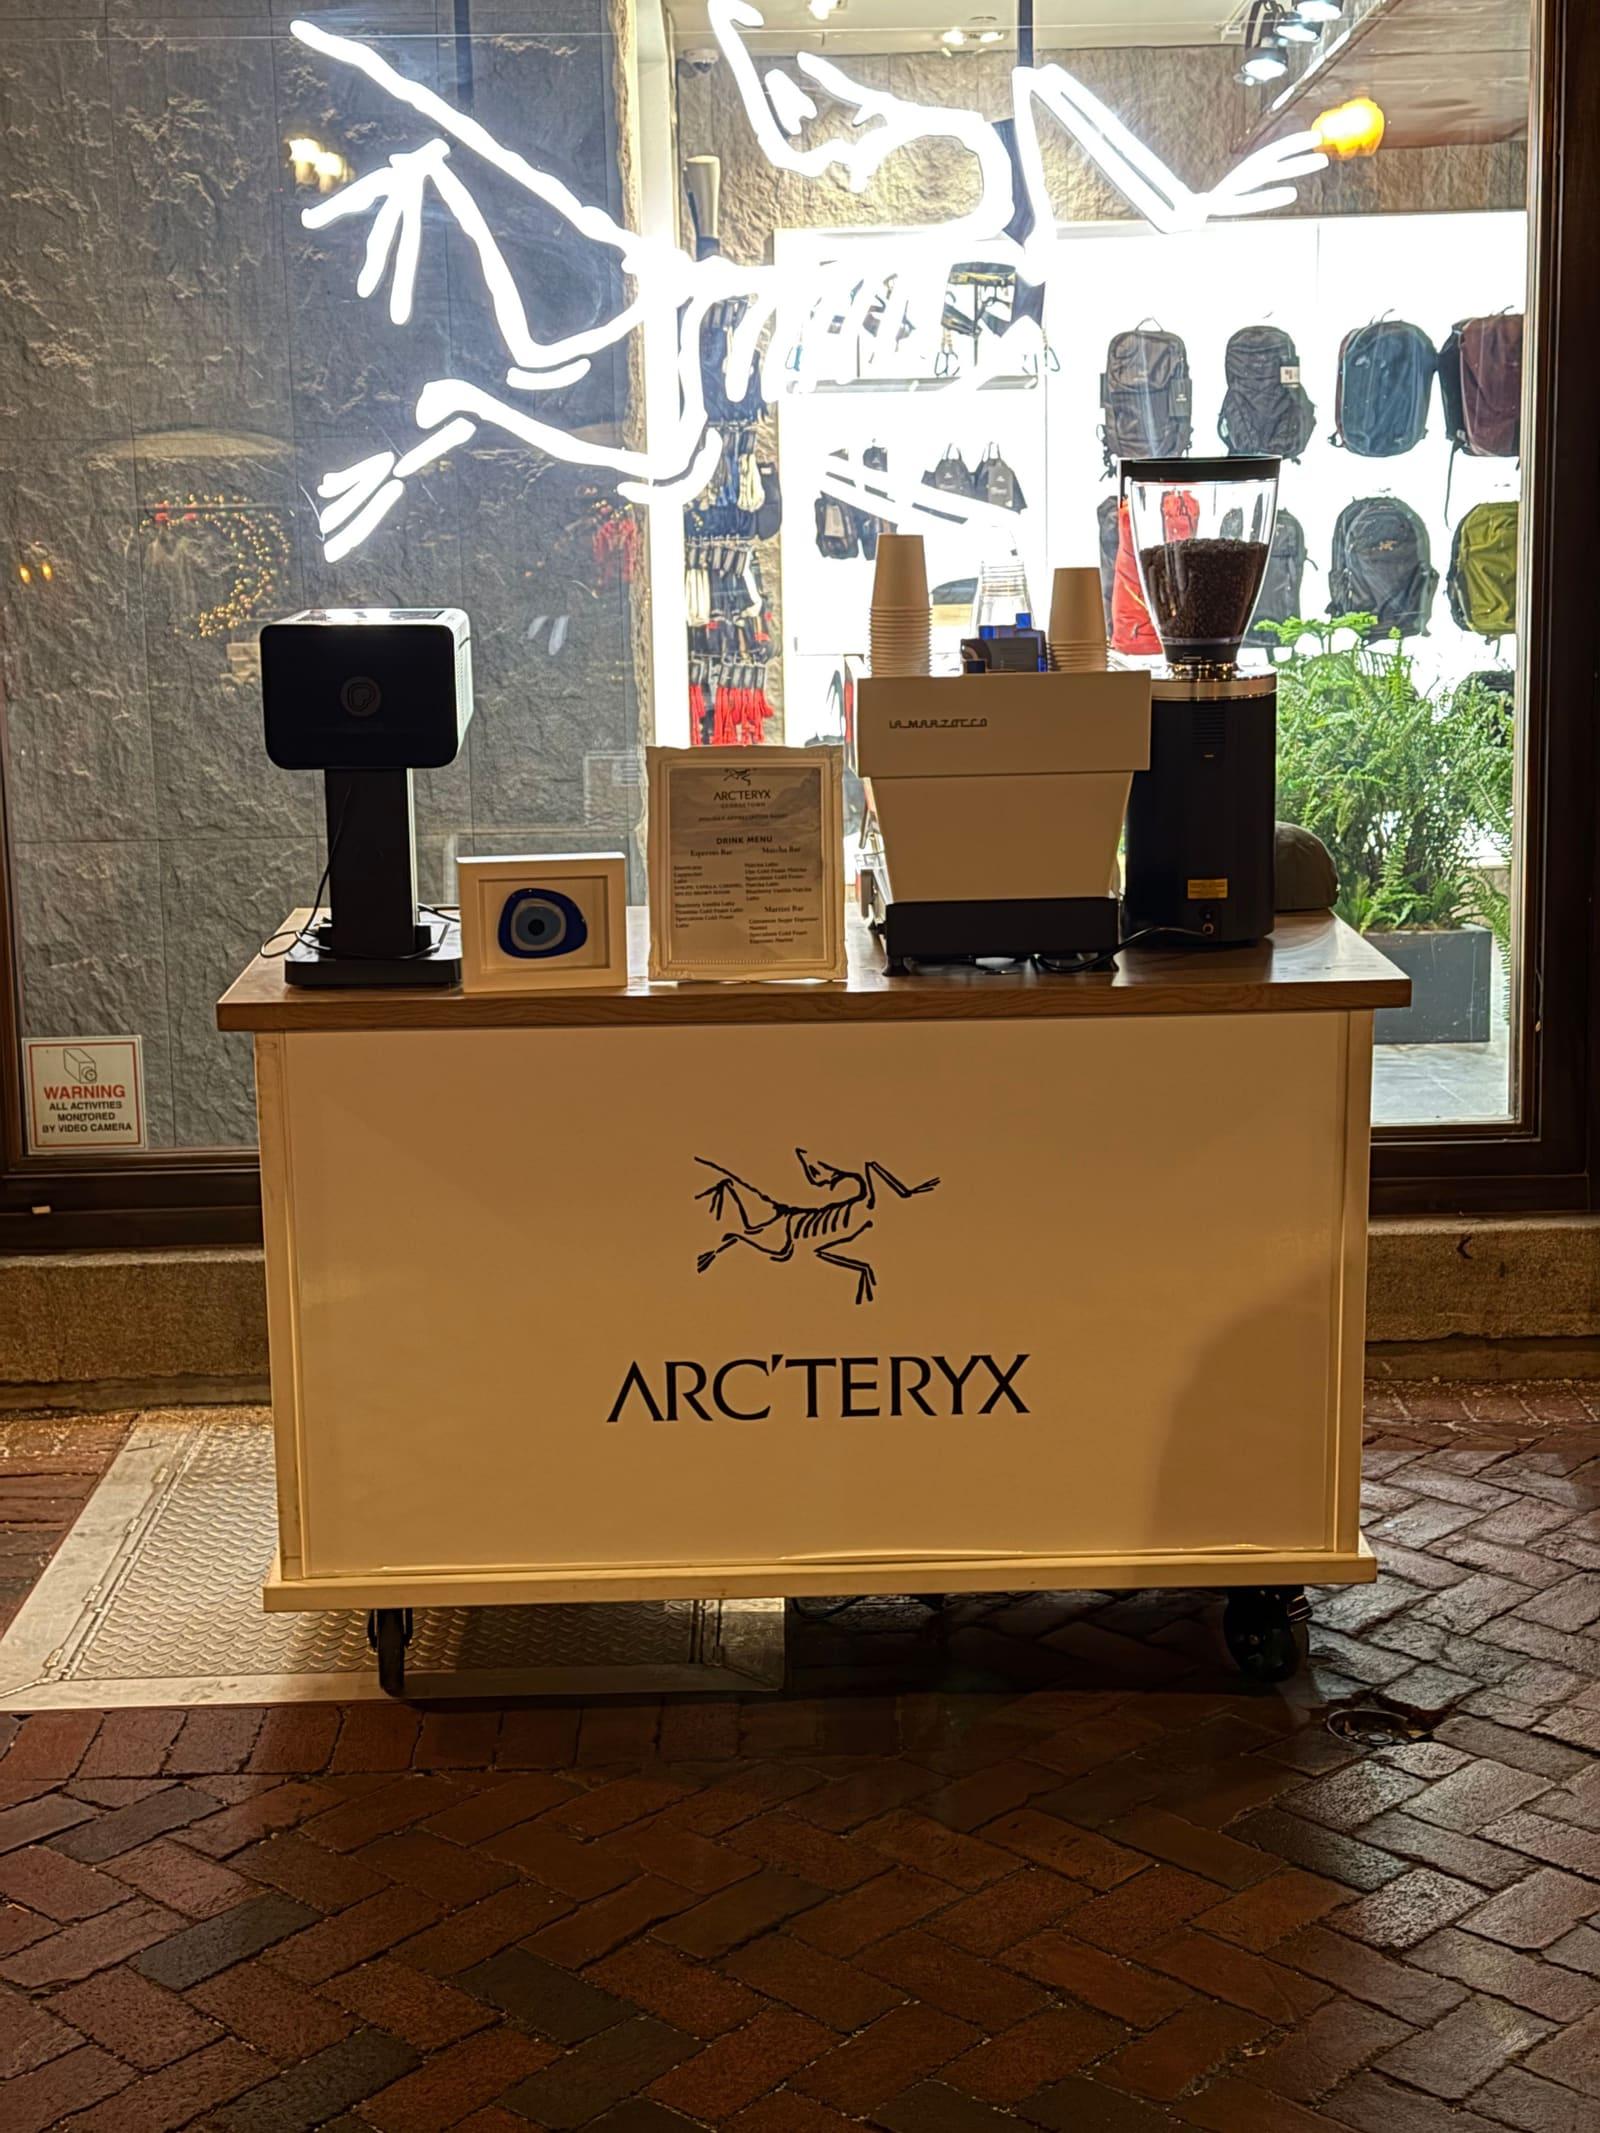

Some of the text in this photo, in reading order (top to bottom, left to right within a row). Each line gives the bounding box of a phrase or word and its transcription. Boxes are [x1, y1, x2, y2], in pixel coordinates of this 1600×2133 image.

[716, 835, 773, 845] DRINK MENU
[44, 1085, 126, 1100] WARNING
[49, 1101, 123, 1111] ALL ACTIVITIES
[57, 1112, 116, 1122] MONITORED
[42, 1122, 132, 1133] BY VIDEO CAMERA
[606, 1354, 1031, 1422] ARC'TERYX
